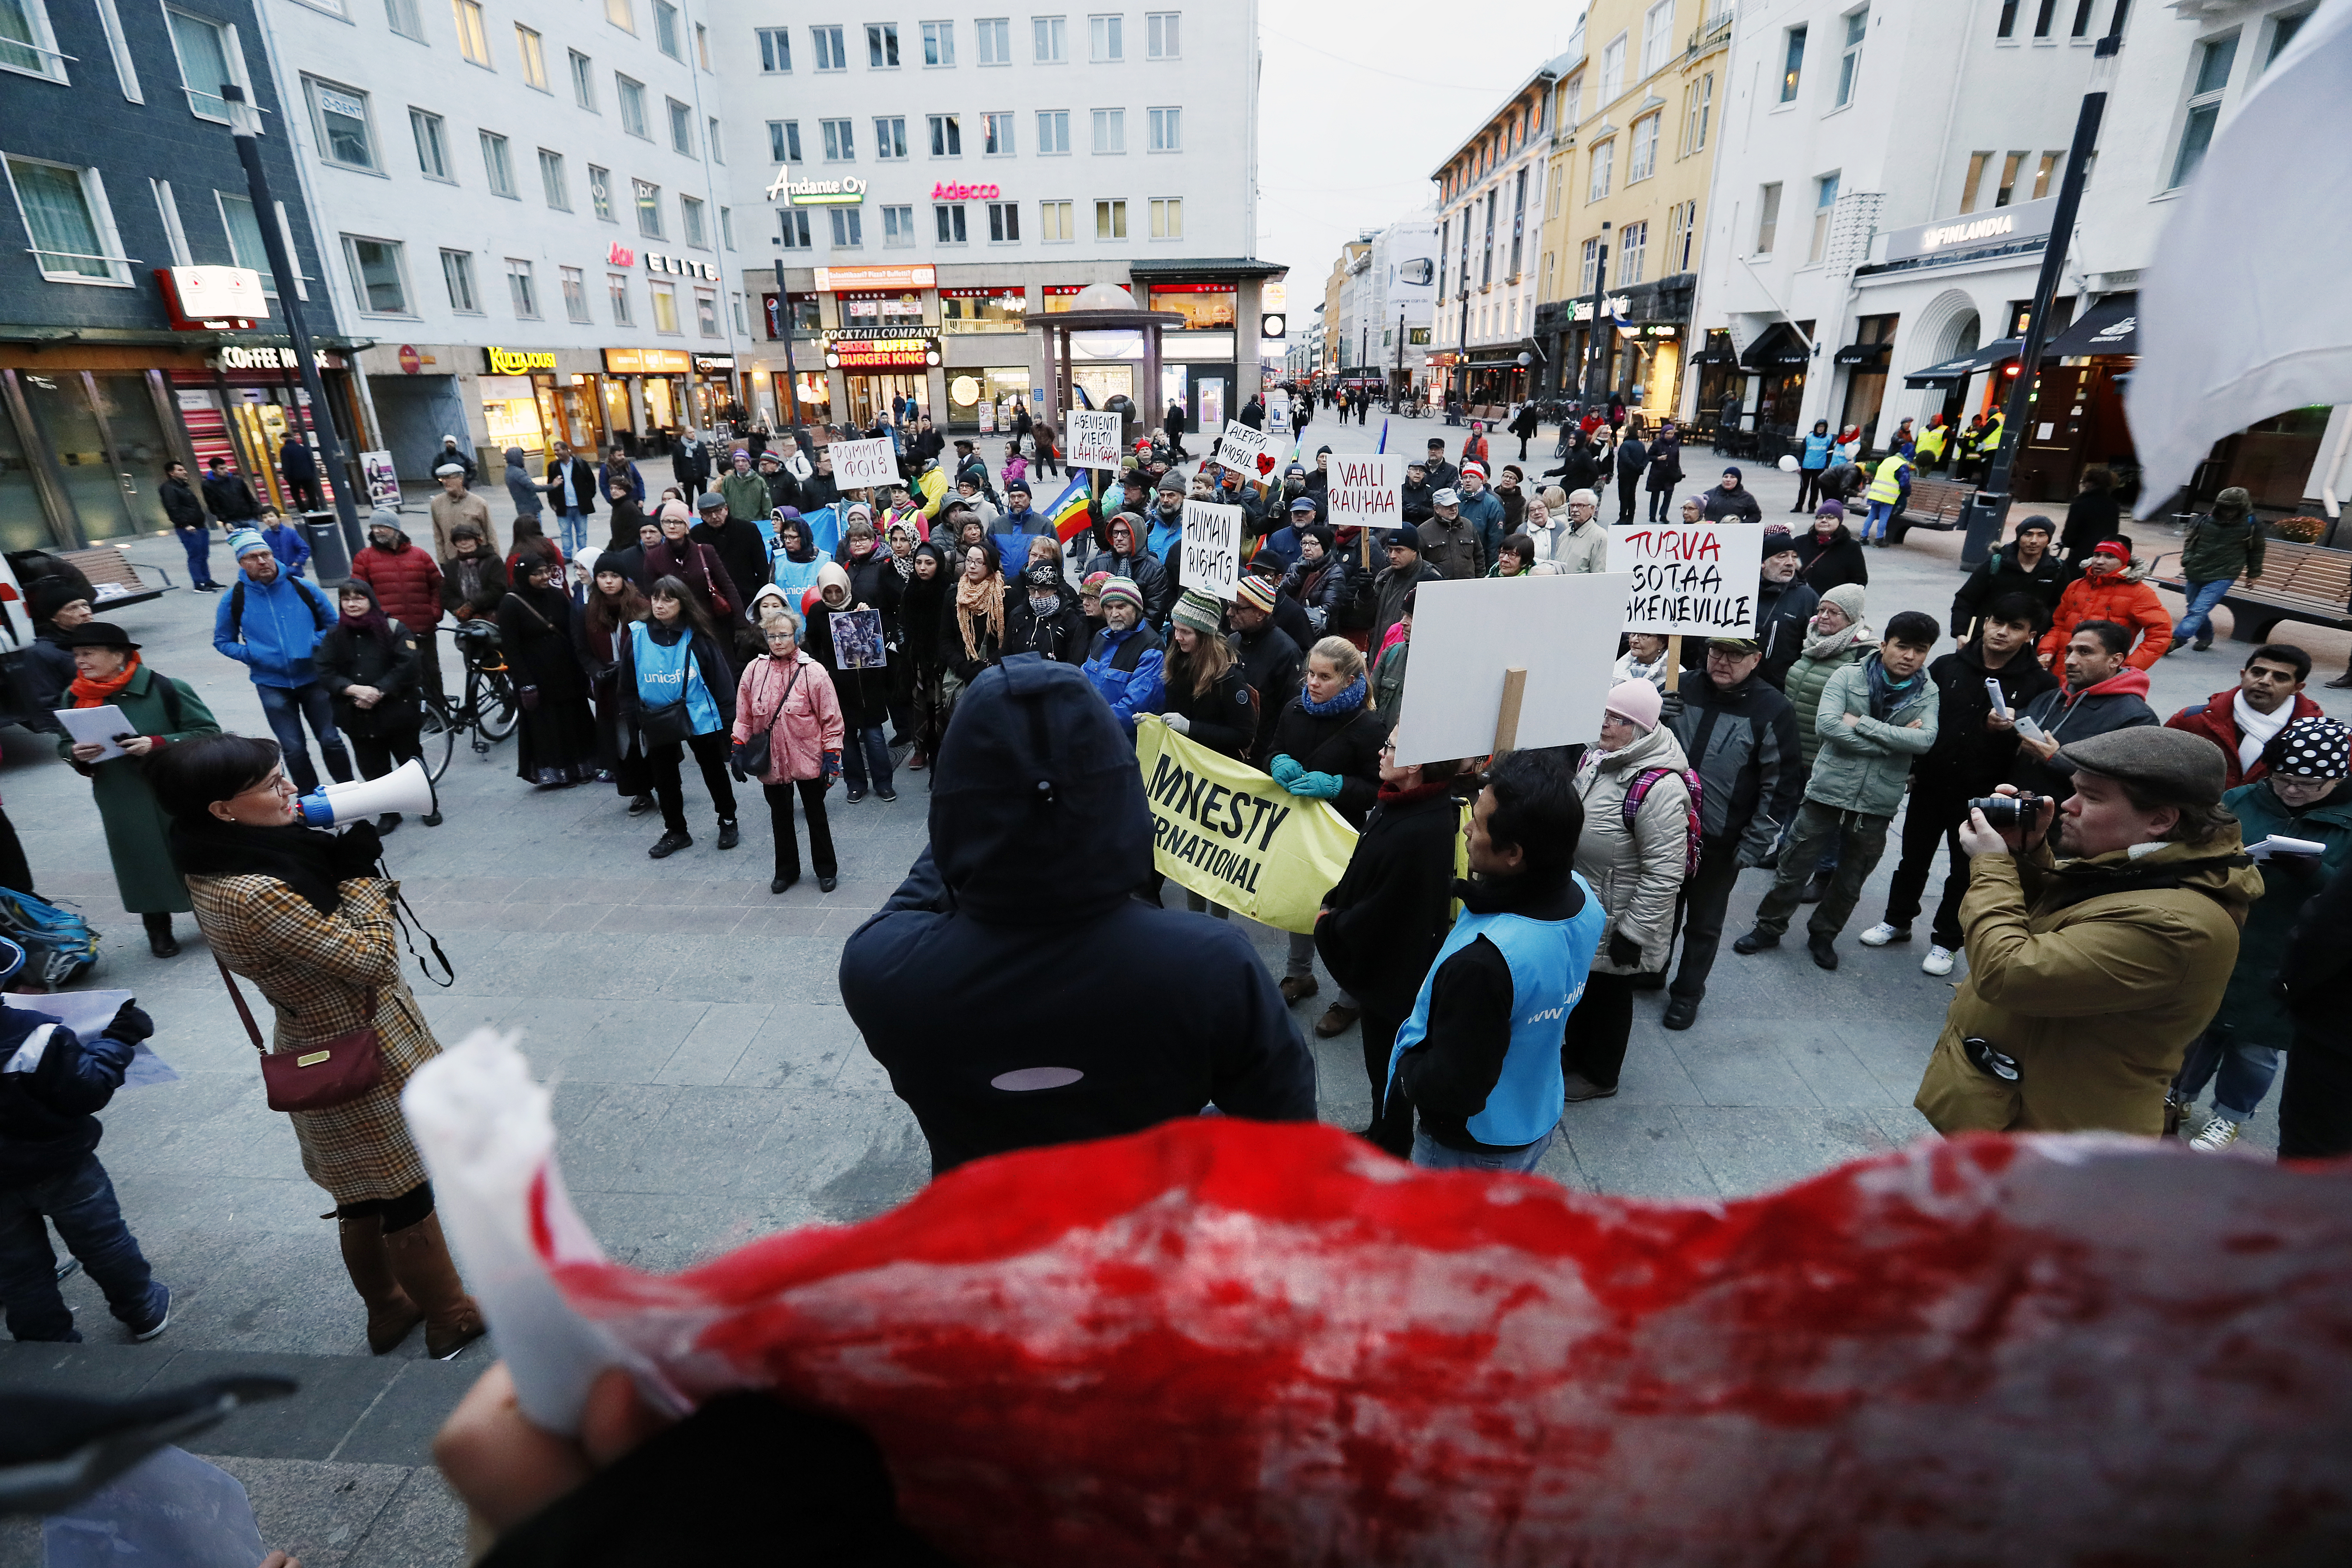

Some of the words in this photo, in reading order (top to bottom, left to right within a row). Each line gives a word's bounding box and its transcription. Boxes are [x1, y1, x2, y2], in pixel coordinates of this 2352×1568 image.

[766, 164, 840, 207] Andante
[842, 175, 867, 194] Oy
[930, 178, 1000, 199] Adecco
[1937, 214, 2012, 245] FINLANDIA
[647, 251, 717, 281] ELITE
[886, 270, 912, 278] Buffetti?
[821, 329, 880, 340] COCKTAIL
[881, 327, 940, 339] COMPANY
[873, 339, 926, 352] BUFFET
[222, 346, 281, 368] COFFEE
[839, 353, 891, 365] BURGER
[892, 352, 925, 364] KING
[833, 439, 886, 461] POMMIT
[1081, 431, 1112, 445] KIELTO
[1228, 426, 1267, 450] ALEPPO
[845, 456, 887, 477] POIS
[1221, 443, 1252, 469] MOSUL
[1338, 461, 1383, 487] VAALI
[1329, 488, 1396, 514] RAUHAA
[1187, 506, 1230, 548] HUMAN
[1625, 530, 1721, 562] TURVA
[1187, 546, 1232, 586] RIGHTS
[1632, 563, 1722, 594] SOTAA
[644, 668, 681, 684] unicef
[1146, 749, 1291, 852] MNESTY
[1151, 812, 1262, 895] RNATIONAL
